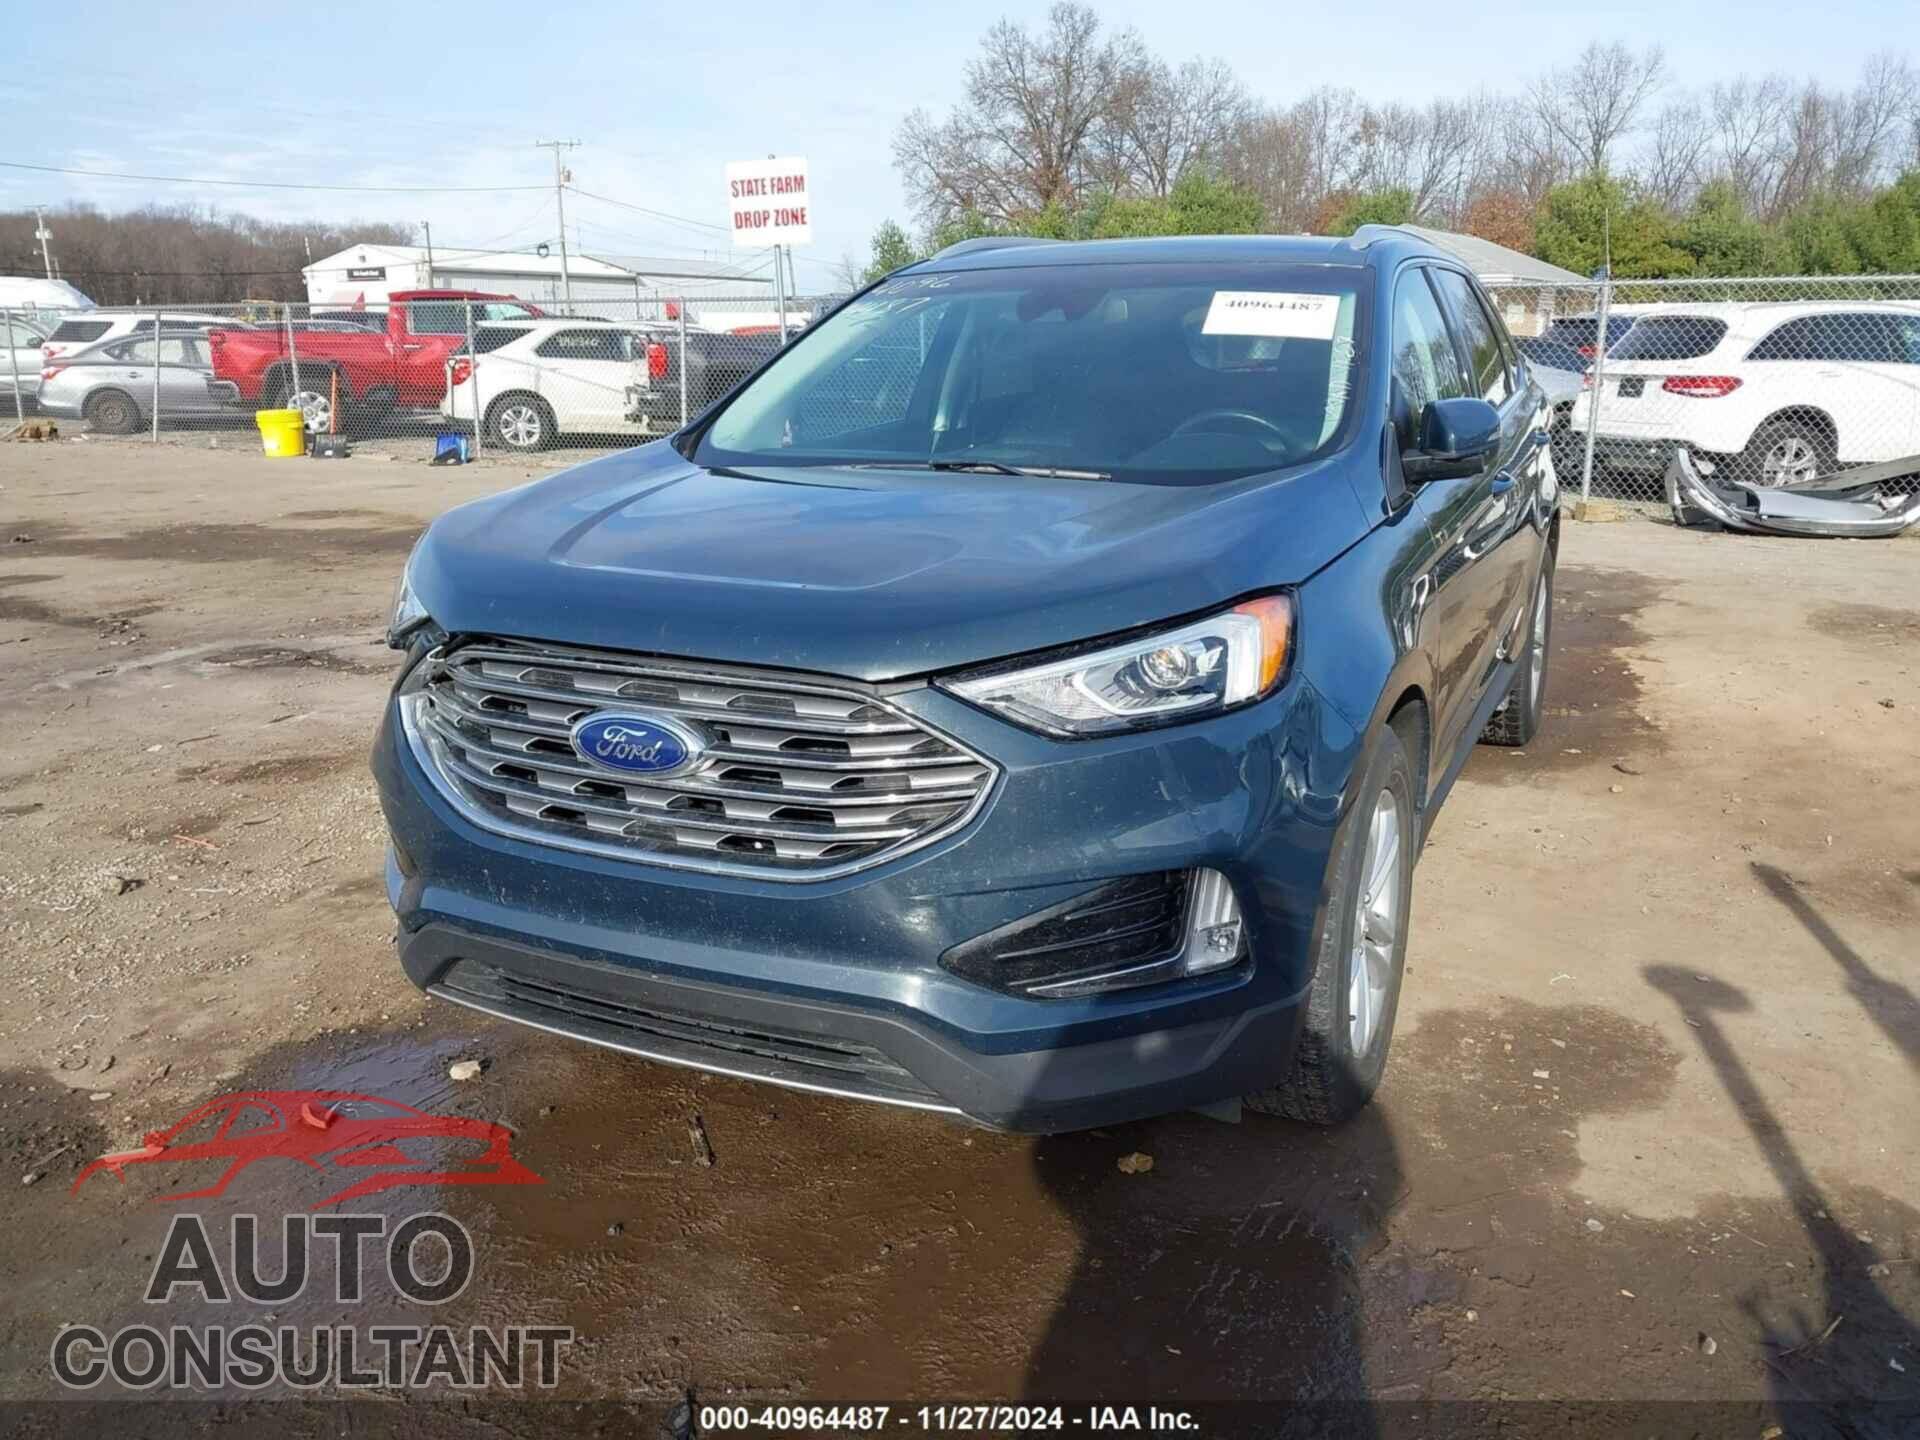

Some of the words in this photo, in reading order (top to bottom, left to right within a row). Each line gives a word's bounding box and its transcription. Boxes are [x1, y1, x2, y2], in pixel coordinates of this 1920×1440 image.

[730, 178, 768, 198] STATE
[769, 174, 806, 195] FARM
[734, 209, 771, 230] DROP
[773, 206, 807, 227] ZONE
[595, 725, 664, 765] Ford
